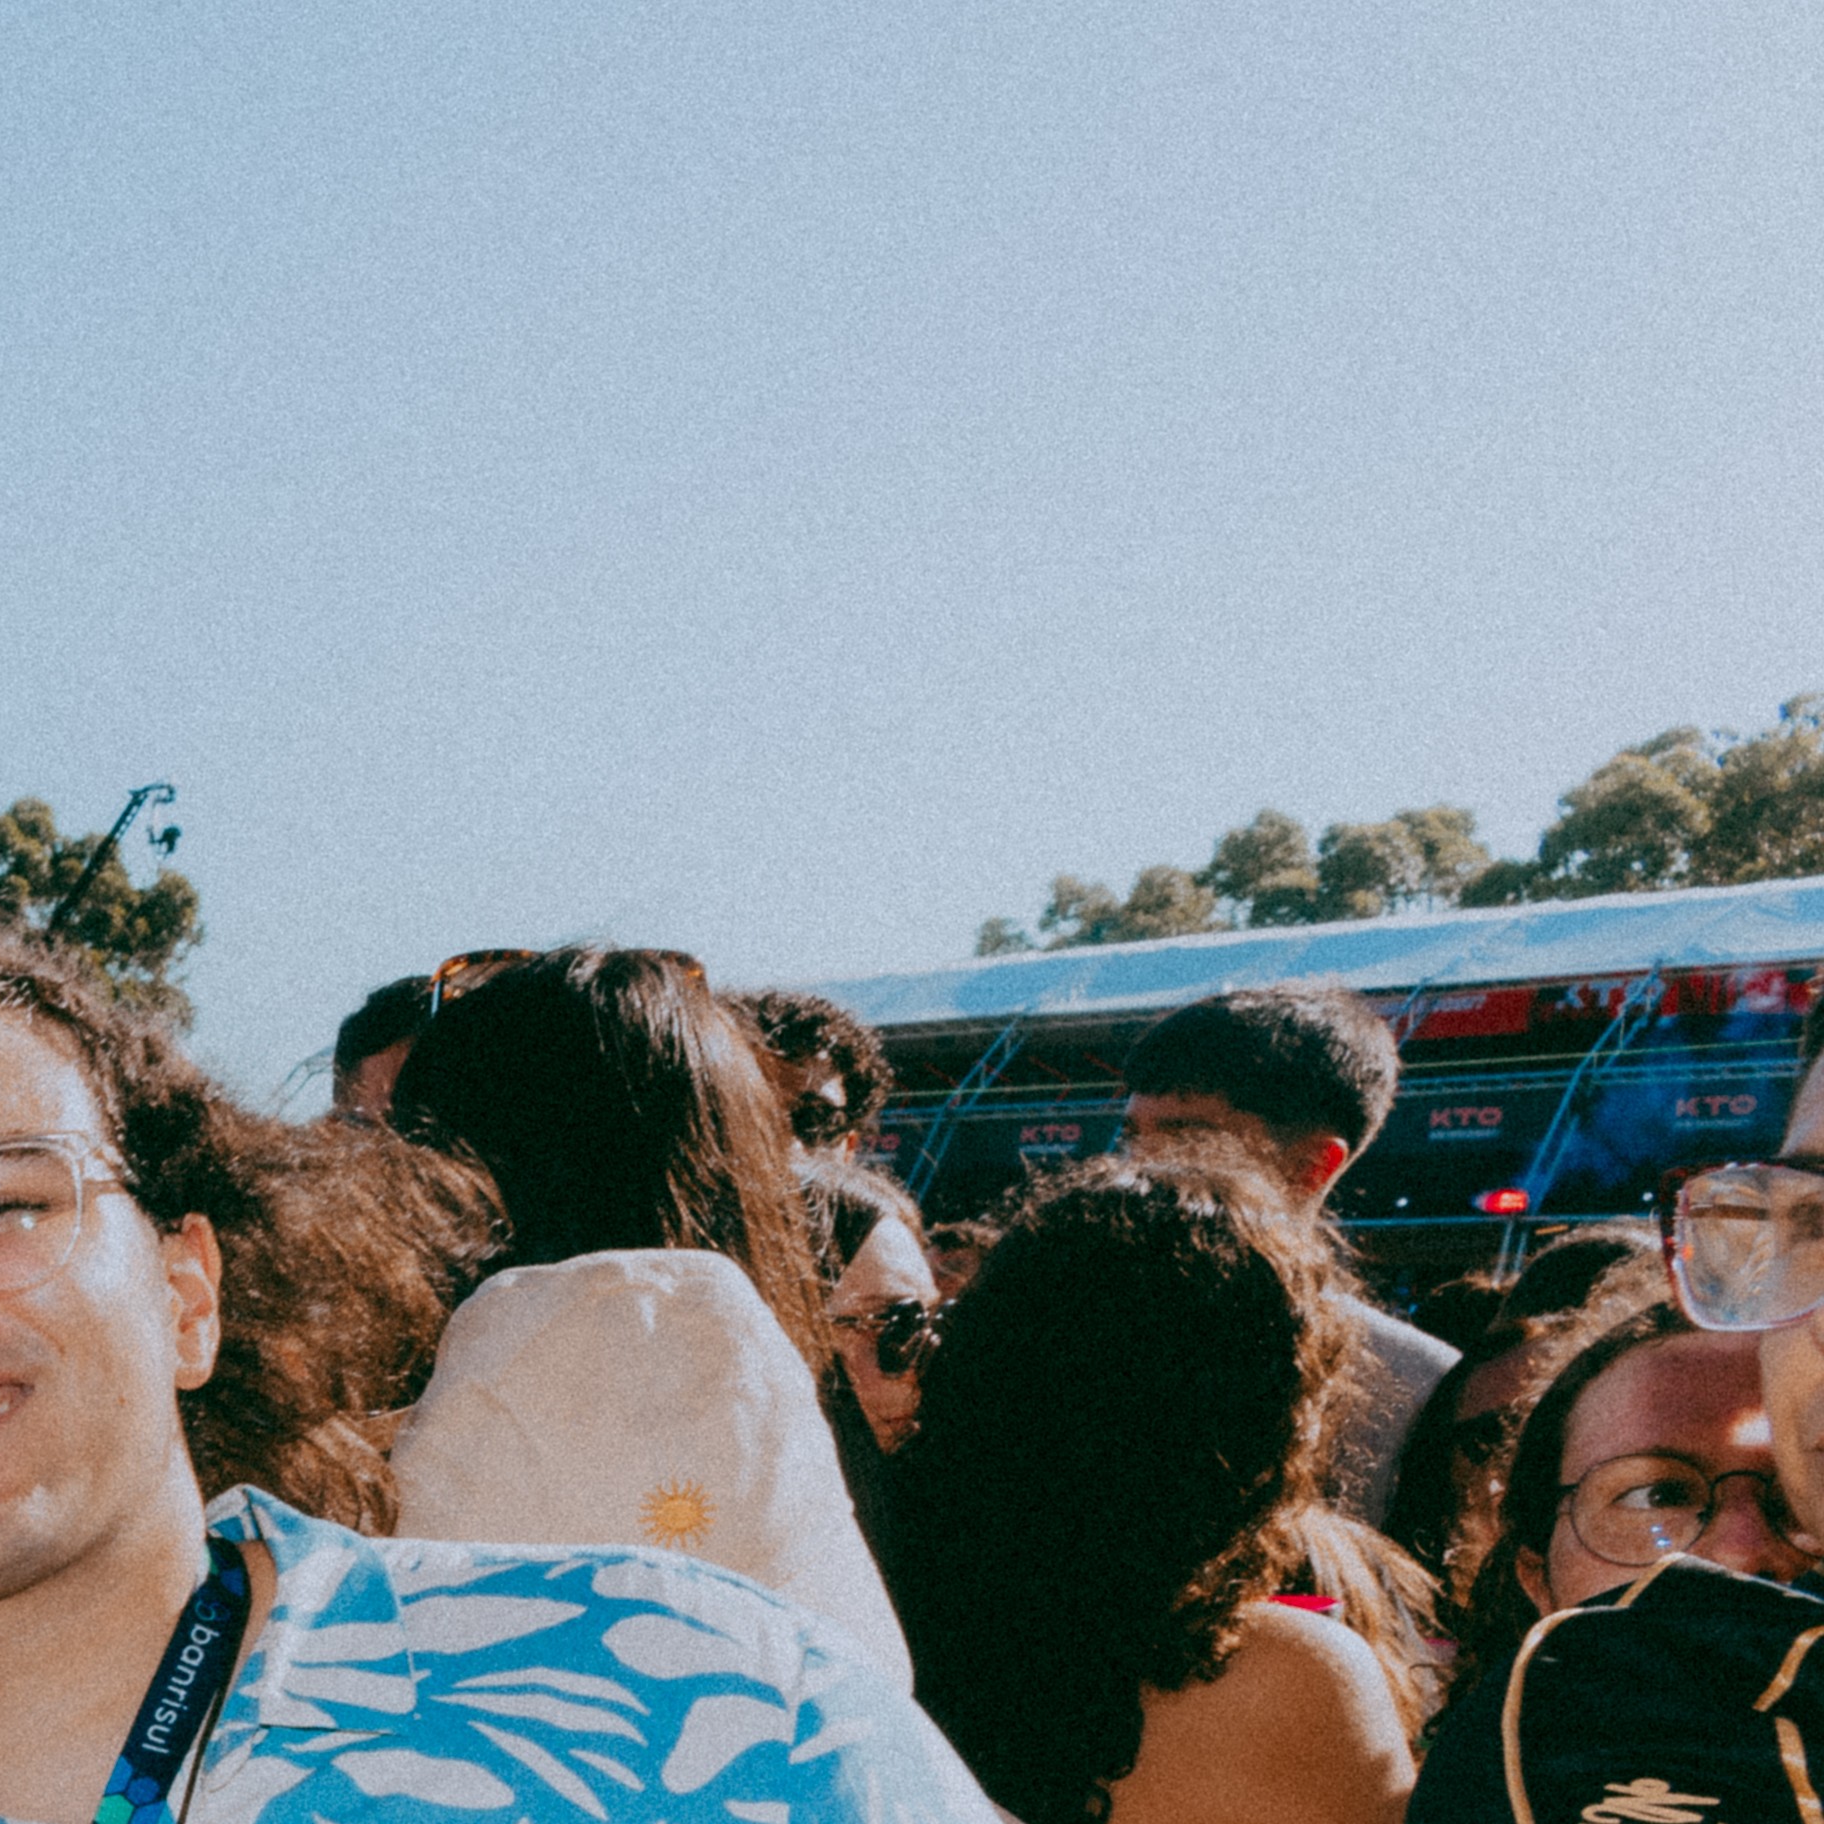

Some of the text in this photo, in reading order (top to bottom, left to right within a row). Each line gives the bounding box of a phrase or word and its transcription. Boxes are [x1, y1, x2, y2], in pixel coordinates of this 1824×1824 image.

[1429, 1106, 1503, 1129] KTO
[1675, 1094, 1758, 1118] KTO
[1019, 1122, 1082, 1143] KTO
[141, 1613, 220, 1754] banrisul
